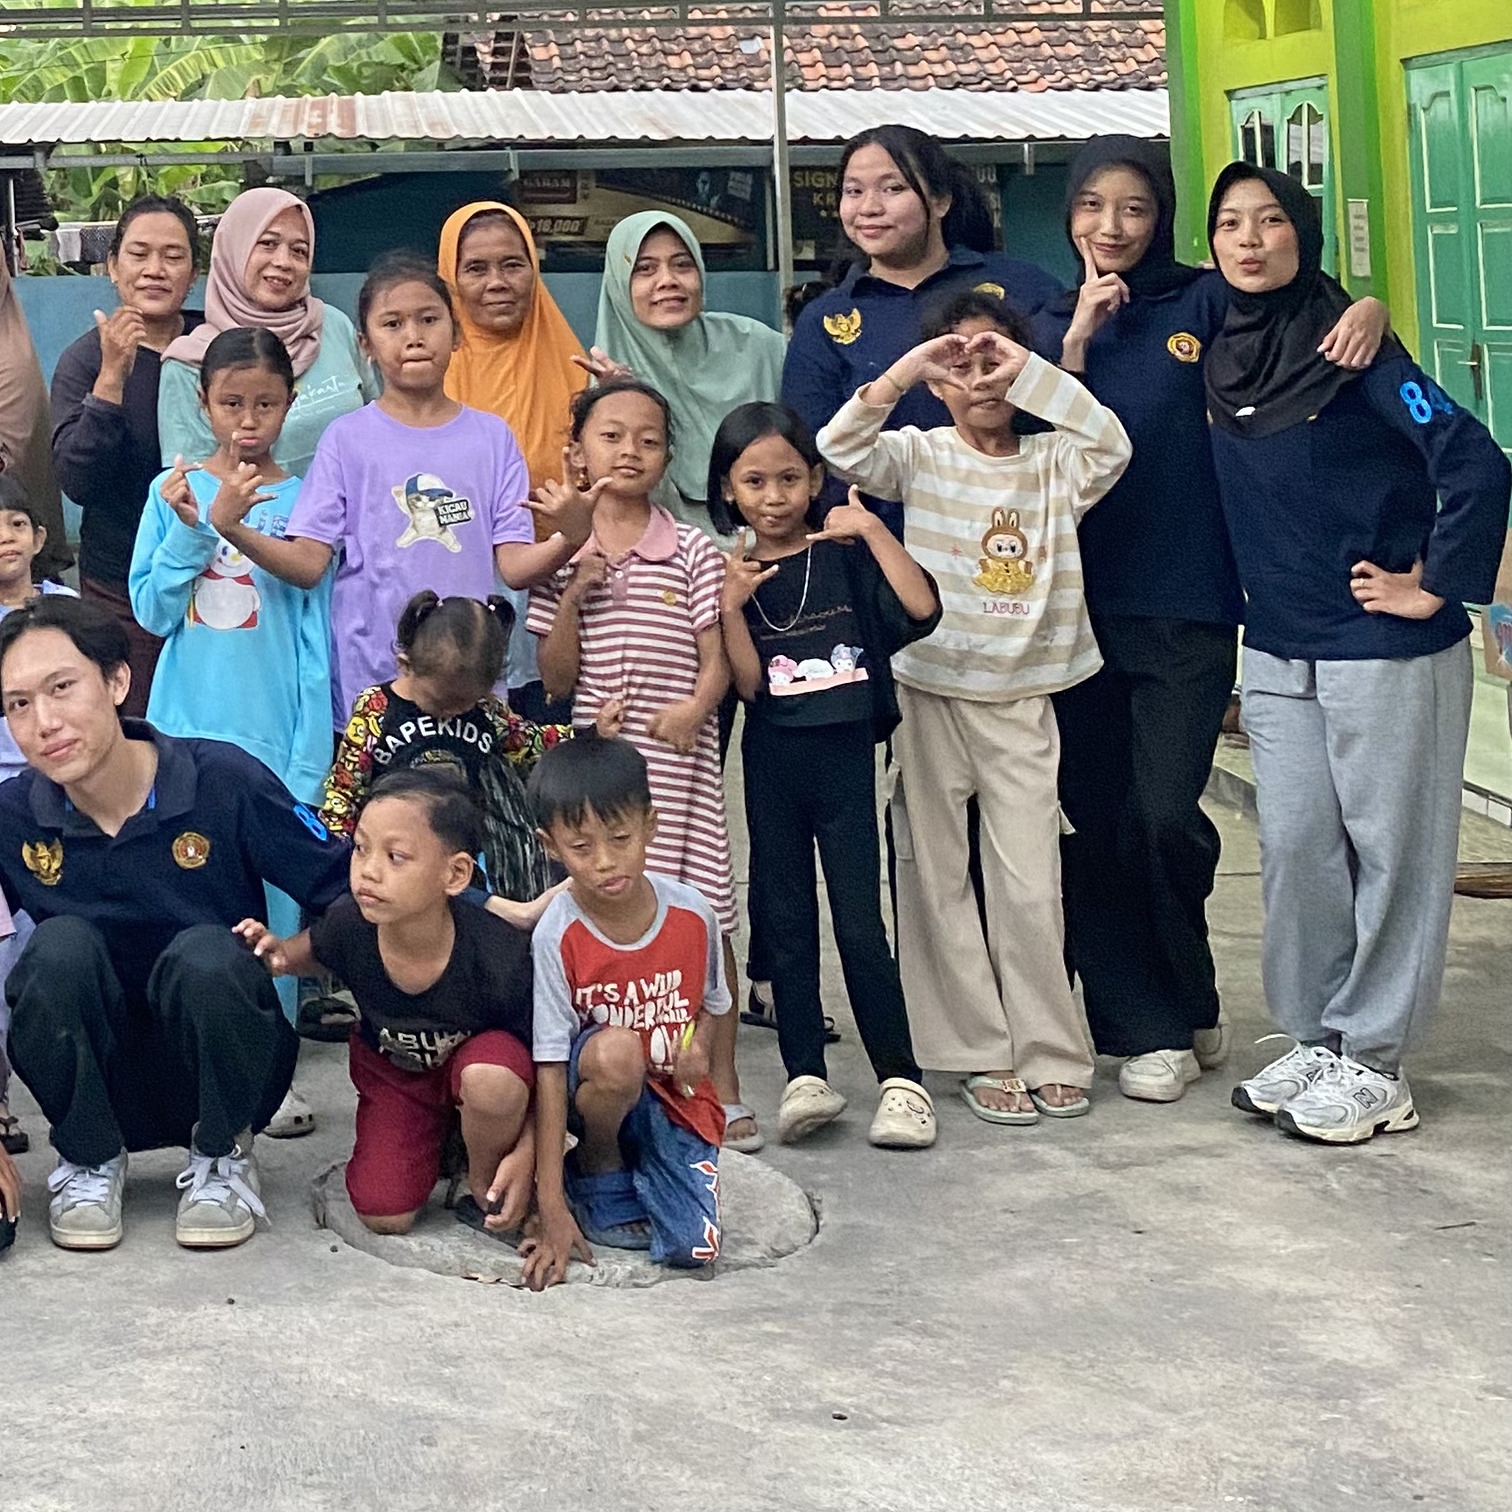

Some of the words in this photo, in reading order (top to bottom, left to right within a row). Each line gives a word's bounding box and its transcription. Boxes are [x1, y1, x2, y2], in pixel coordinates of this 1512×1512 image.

[792, 170, 839, 188] SIGN
[982, 601, 1030, 615] LABUBU
[373, 715, 493, 765] BAPEKIDS
[575, 983, 620, 1005] IT'S
[624, 981, 639, 1005] A
